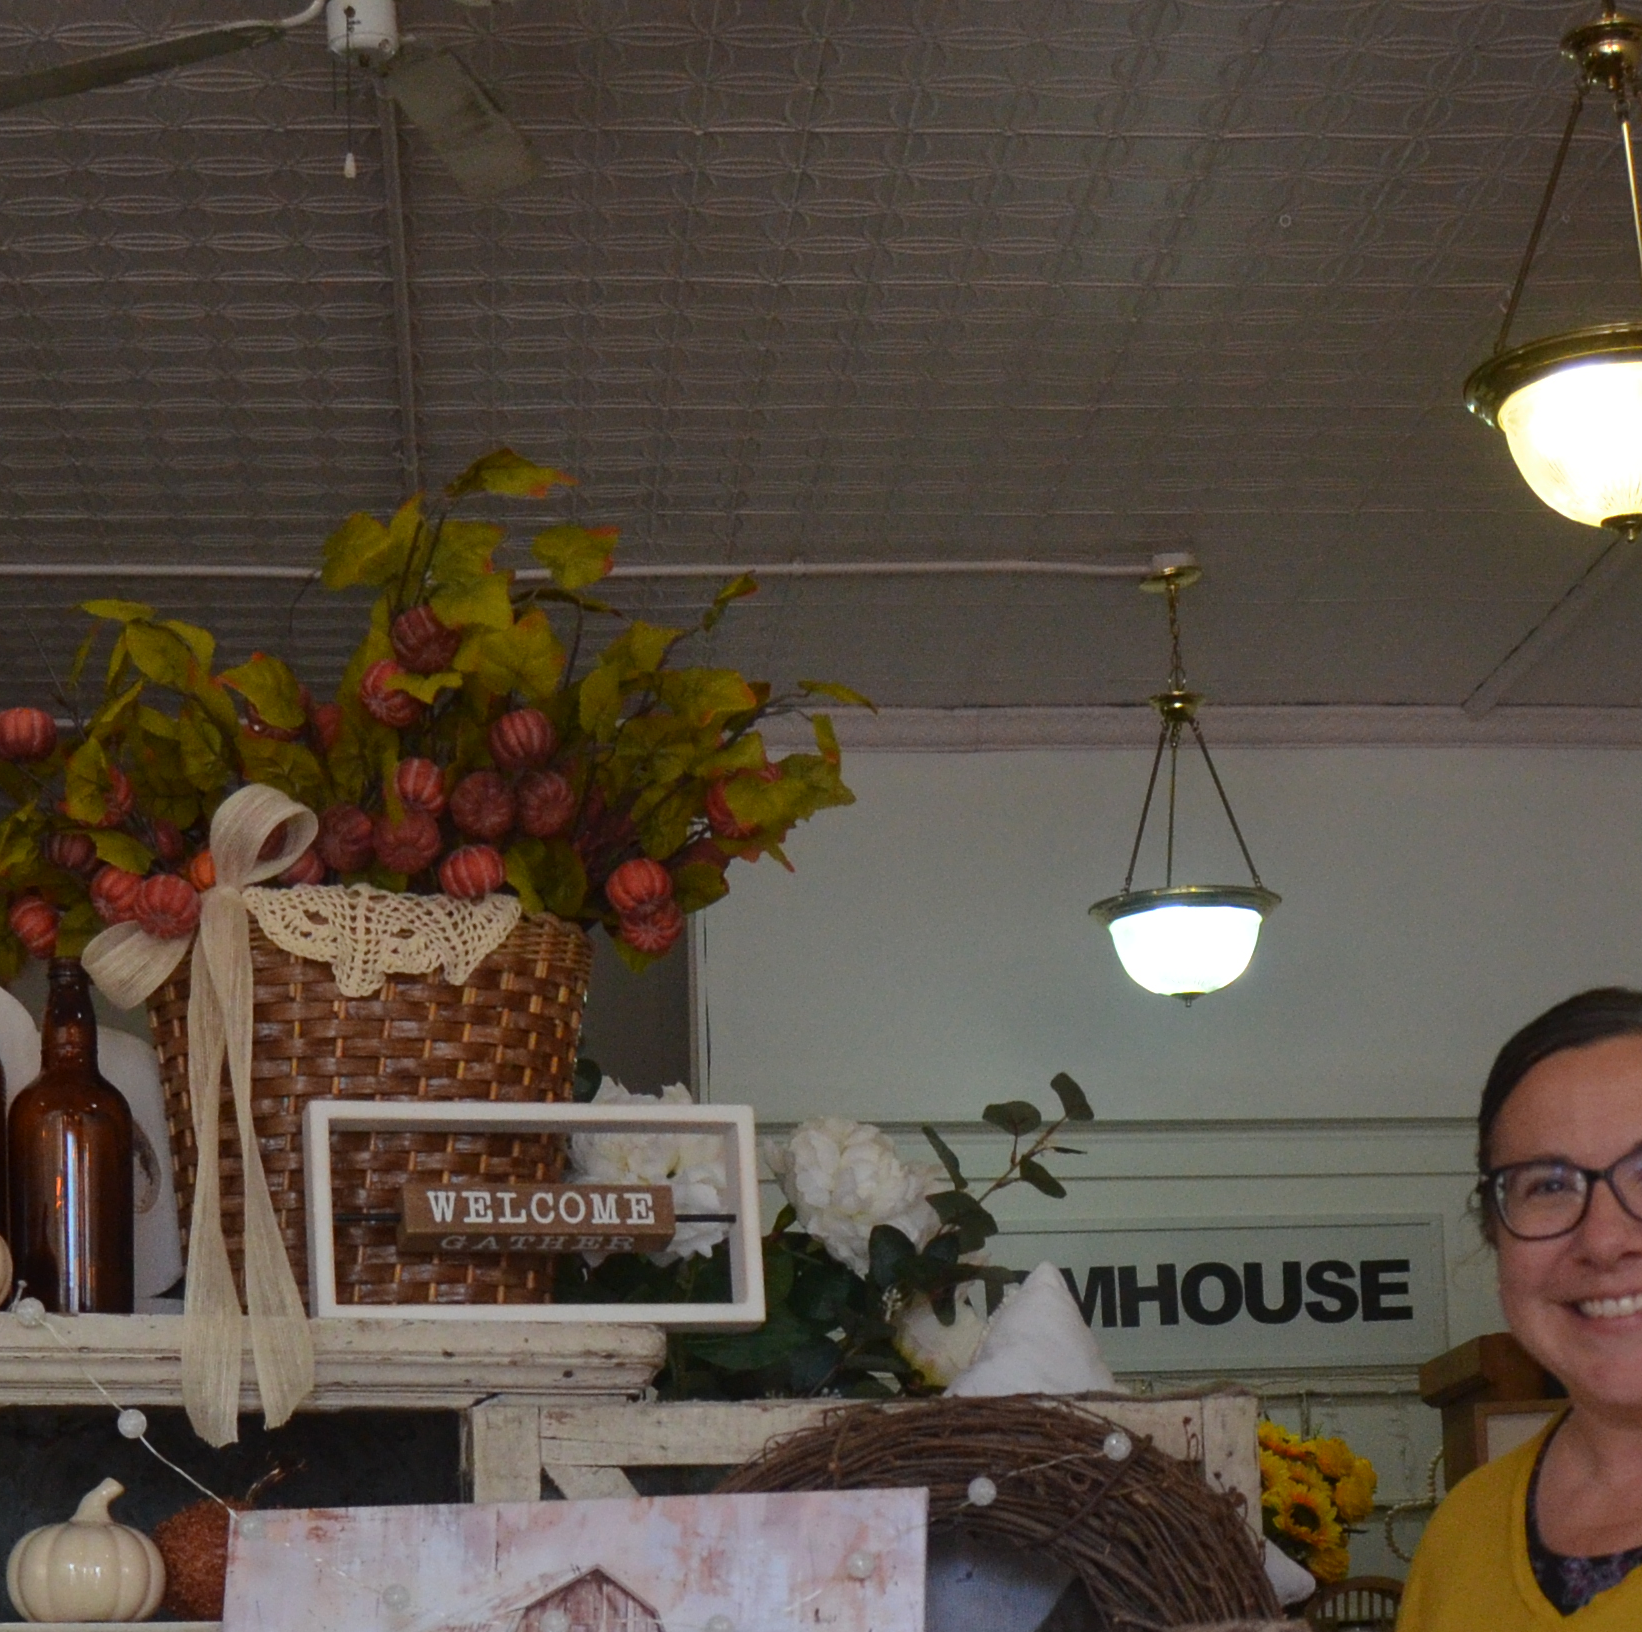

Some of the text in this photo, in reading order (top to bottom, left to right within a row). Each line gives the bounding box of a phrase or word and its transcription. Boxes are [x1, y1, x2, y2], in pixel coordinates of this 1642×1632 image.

[426, 1190, 656, 1225] WELCOME
[440, 1235, 636, 1251] GATHER
[984, 1258, 1413, 1328] MHOUSE
